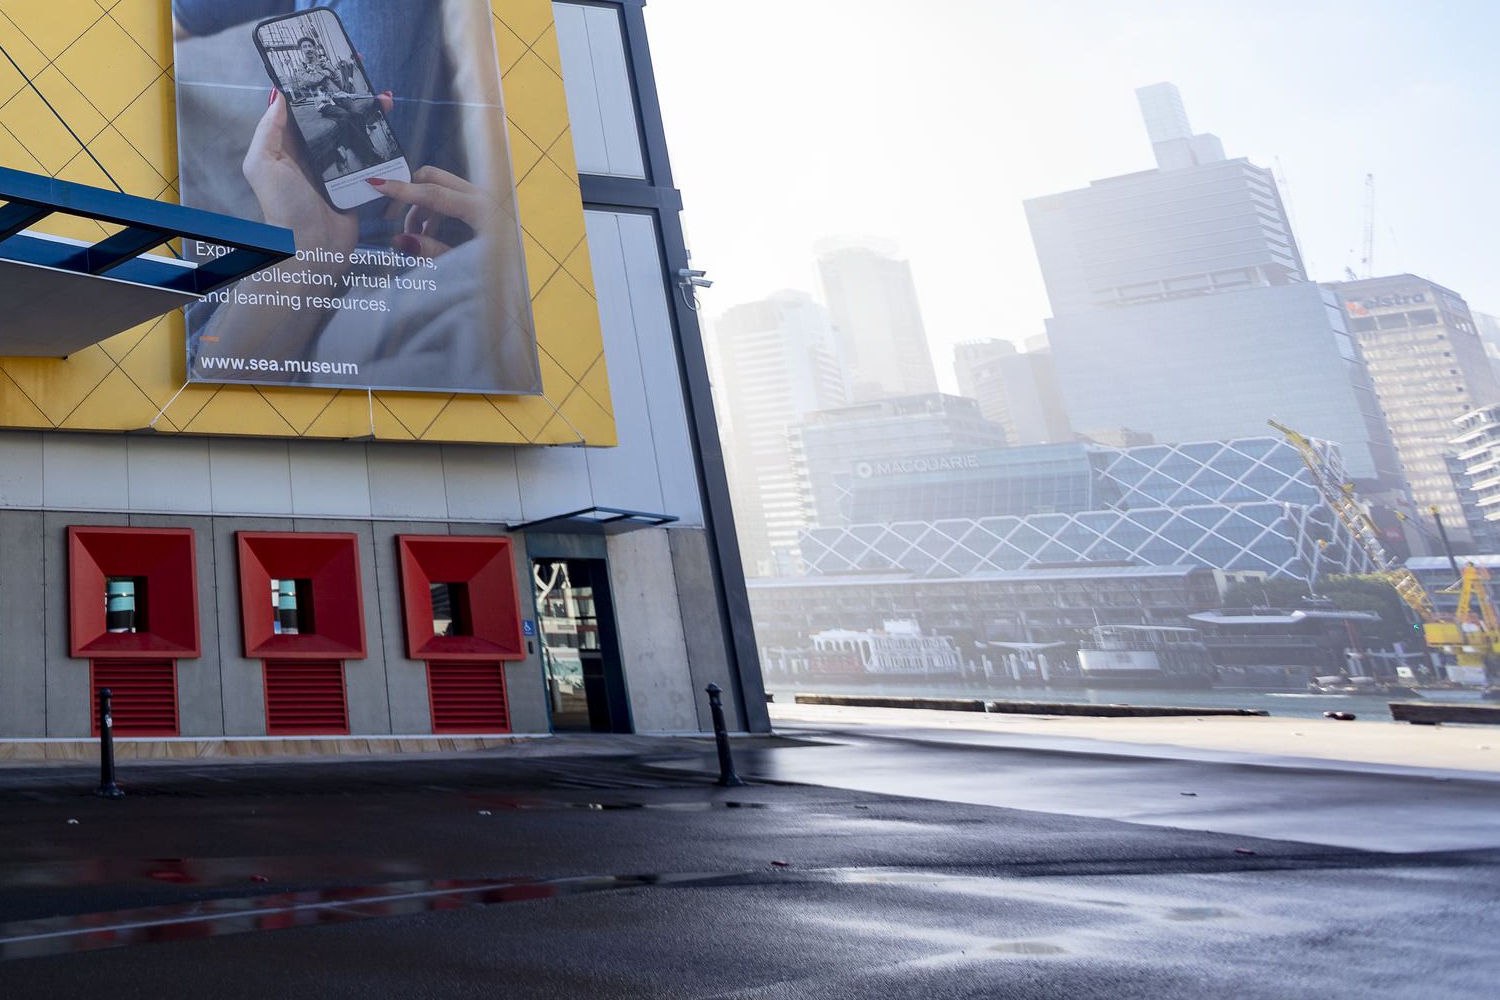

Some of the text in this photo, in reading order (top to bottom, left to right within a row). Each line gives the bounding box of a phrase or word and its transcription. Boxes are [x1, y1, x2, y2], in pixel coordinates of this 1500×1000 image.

[295, 247, 345, 264] online
[348, 249, 438, 270] exhibitions,
[251, 268, 437, 292] collection, virtual tours
[234, 290, 301, 311] learning
[306, 295, 391, 312] resources.
[200, 355, 359, 376] www.sea.museum
[877, 455, 980, 473] MACQUARIE
